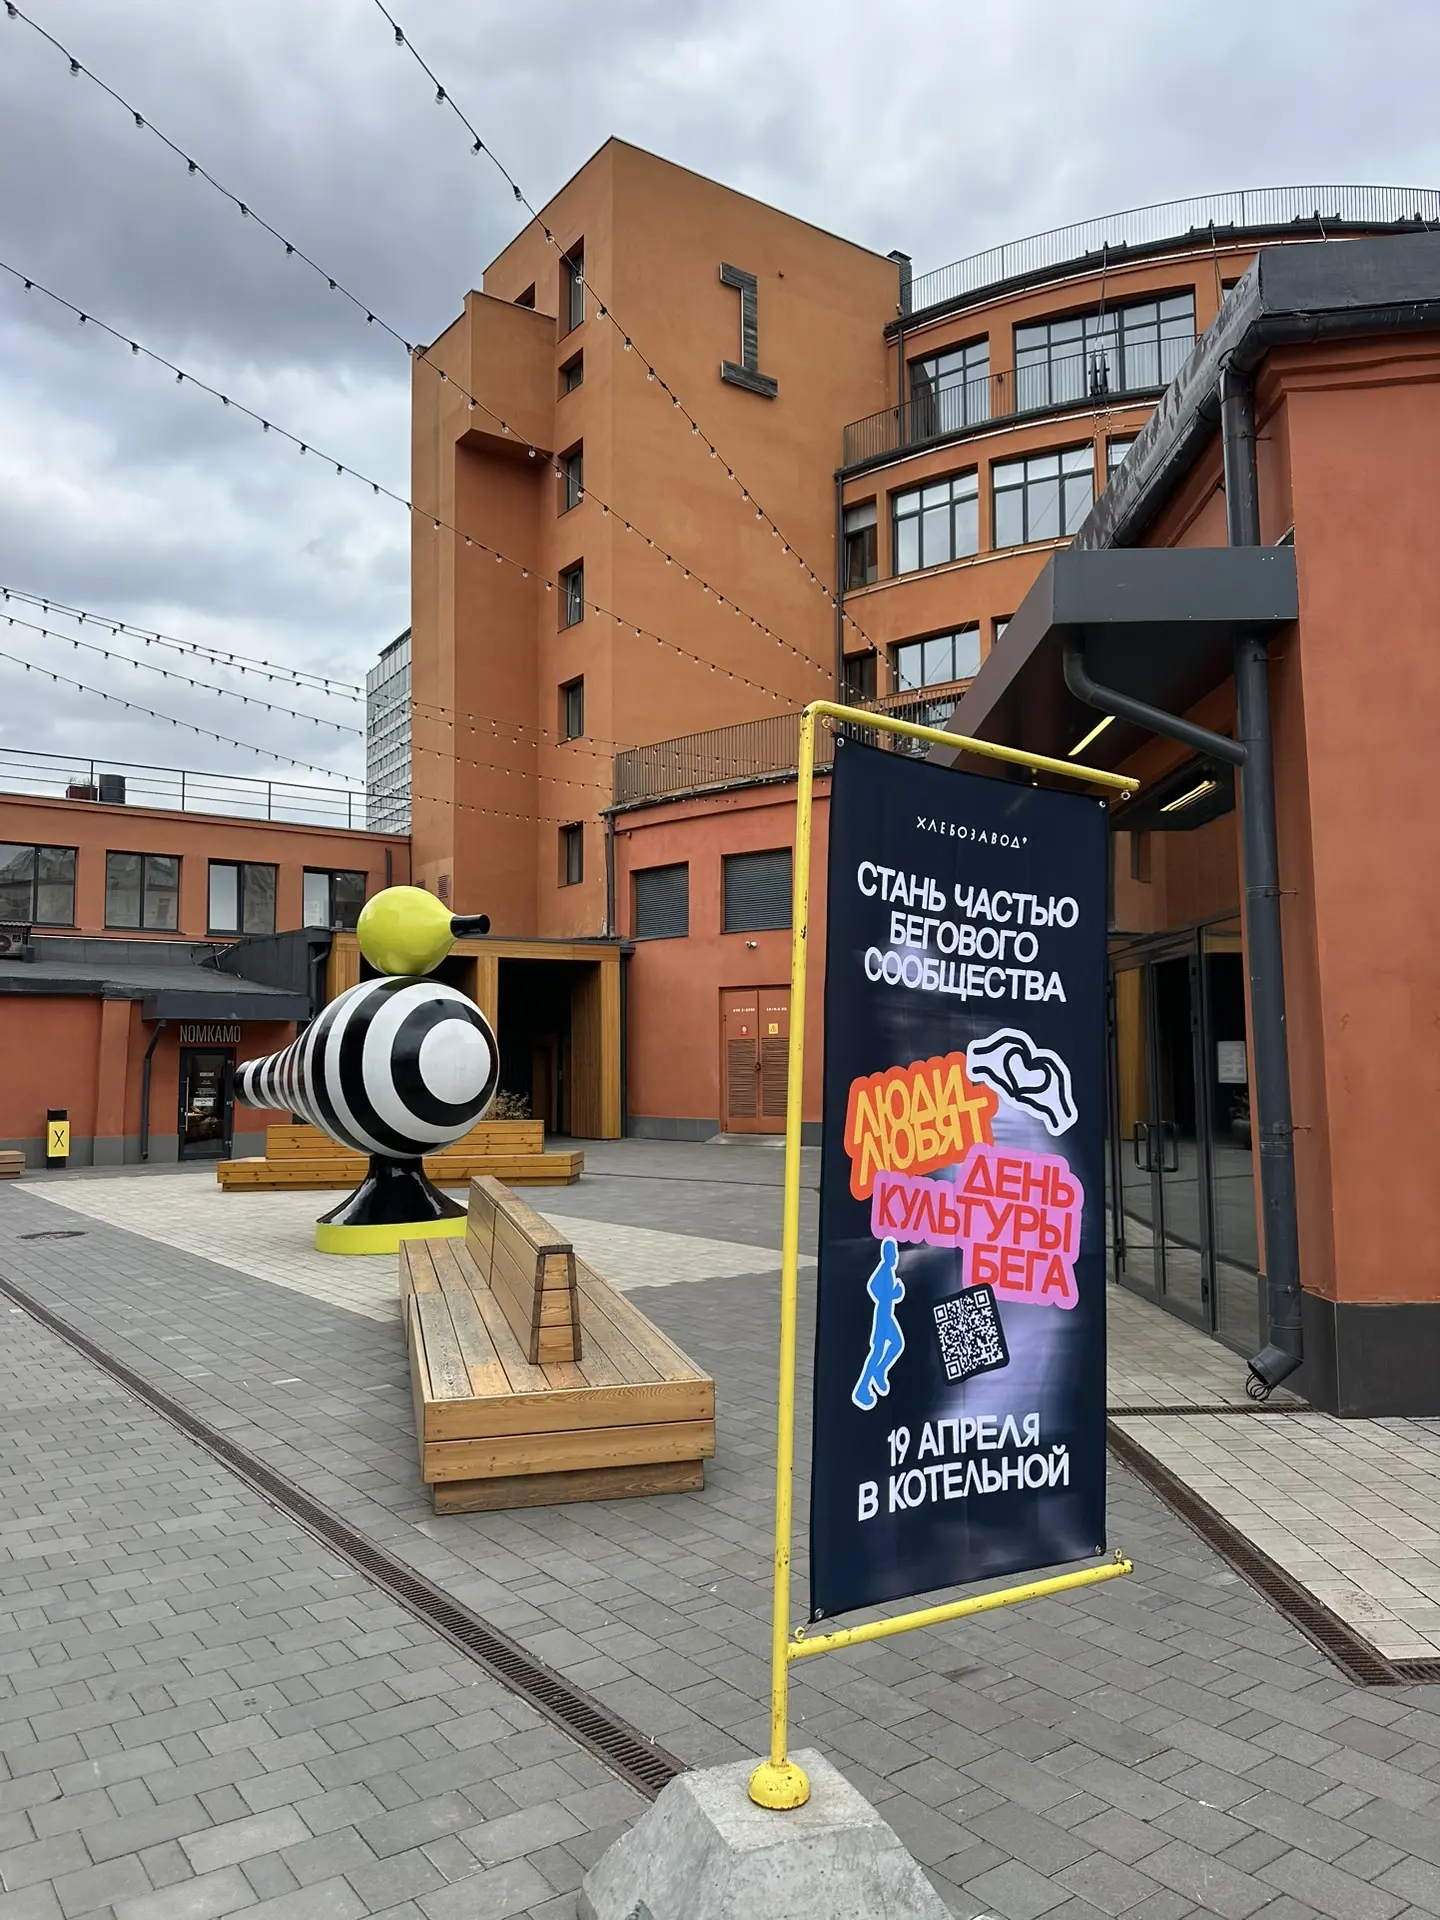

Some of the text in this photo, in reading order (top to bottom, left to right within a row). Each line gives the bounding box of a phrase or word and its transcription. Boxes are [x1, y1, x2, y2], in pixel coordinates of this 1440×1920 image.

[857, 861, 1080, 928] СТАНЬ ЧАСТЬЮ
[889, 910, 1039, 963] БЕГОВОГО
[864, 946, 1067, 1003] СООБЩЕСТВА
[179, 1024, 241, 1043] NOMKAMO
[854, 1064, 966, 1145] ЛЮДИ
[860, 1097, 988, 1186] ЛЮБЯТ
[963, 1154, 1075, 1208] ДЕНЬ
[878, 1182, 1072, 1253] КУЛЬТУРЫ
[971, 1243, 1070, 1297] БЕГА
[887, 1412, 1040, 1467] 19 АПРЕЛЯ
[858, 1444, 1070, 1522] В КОТЕЛЬНОЙ
